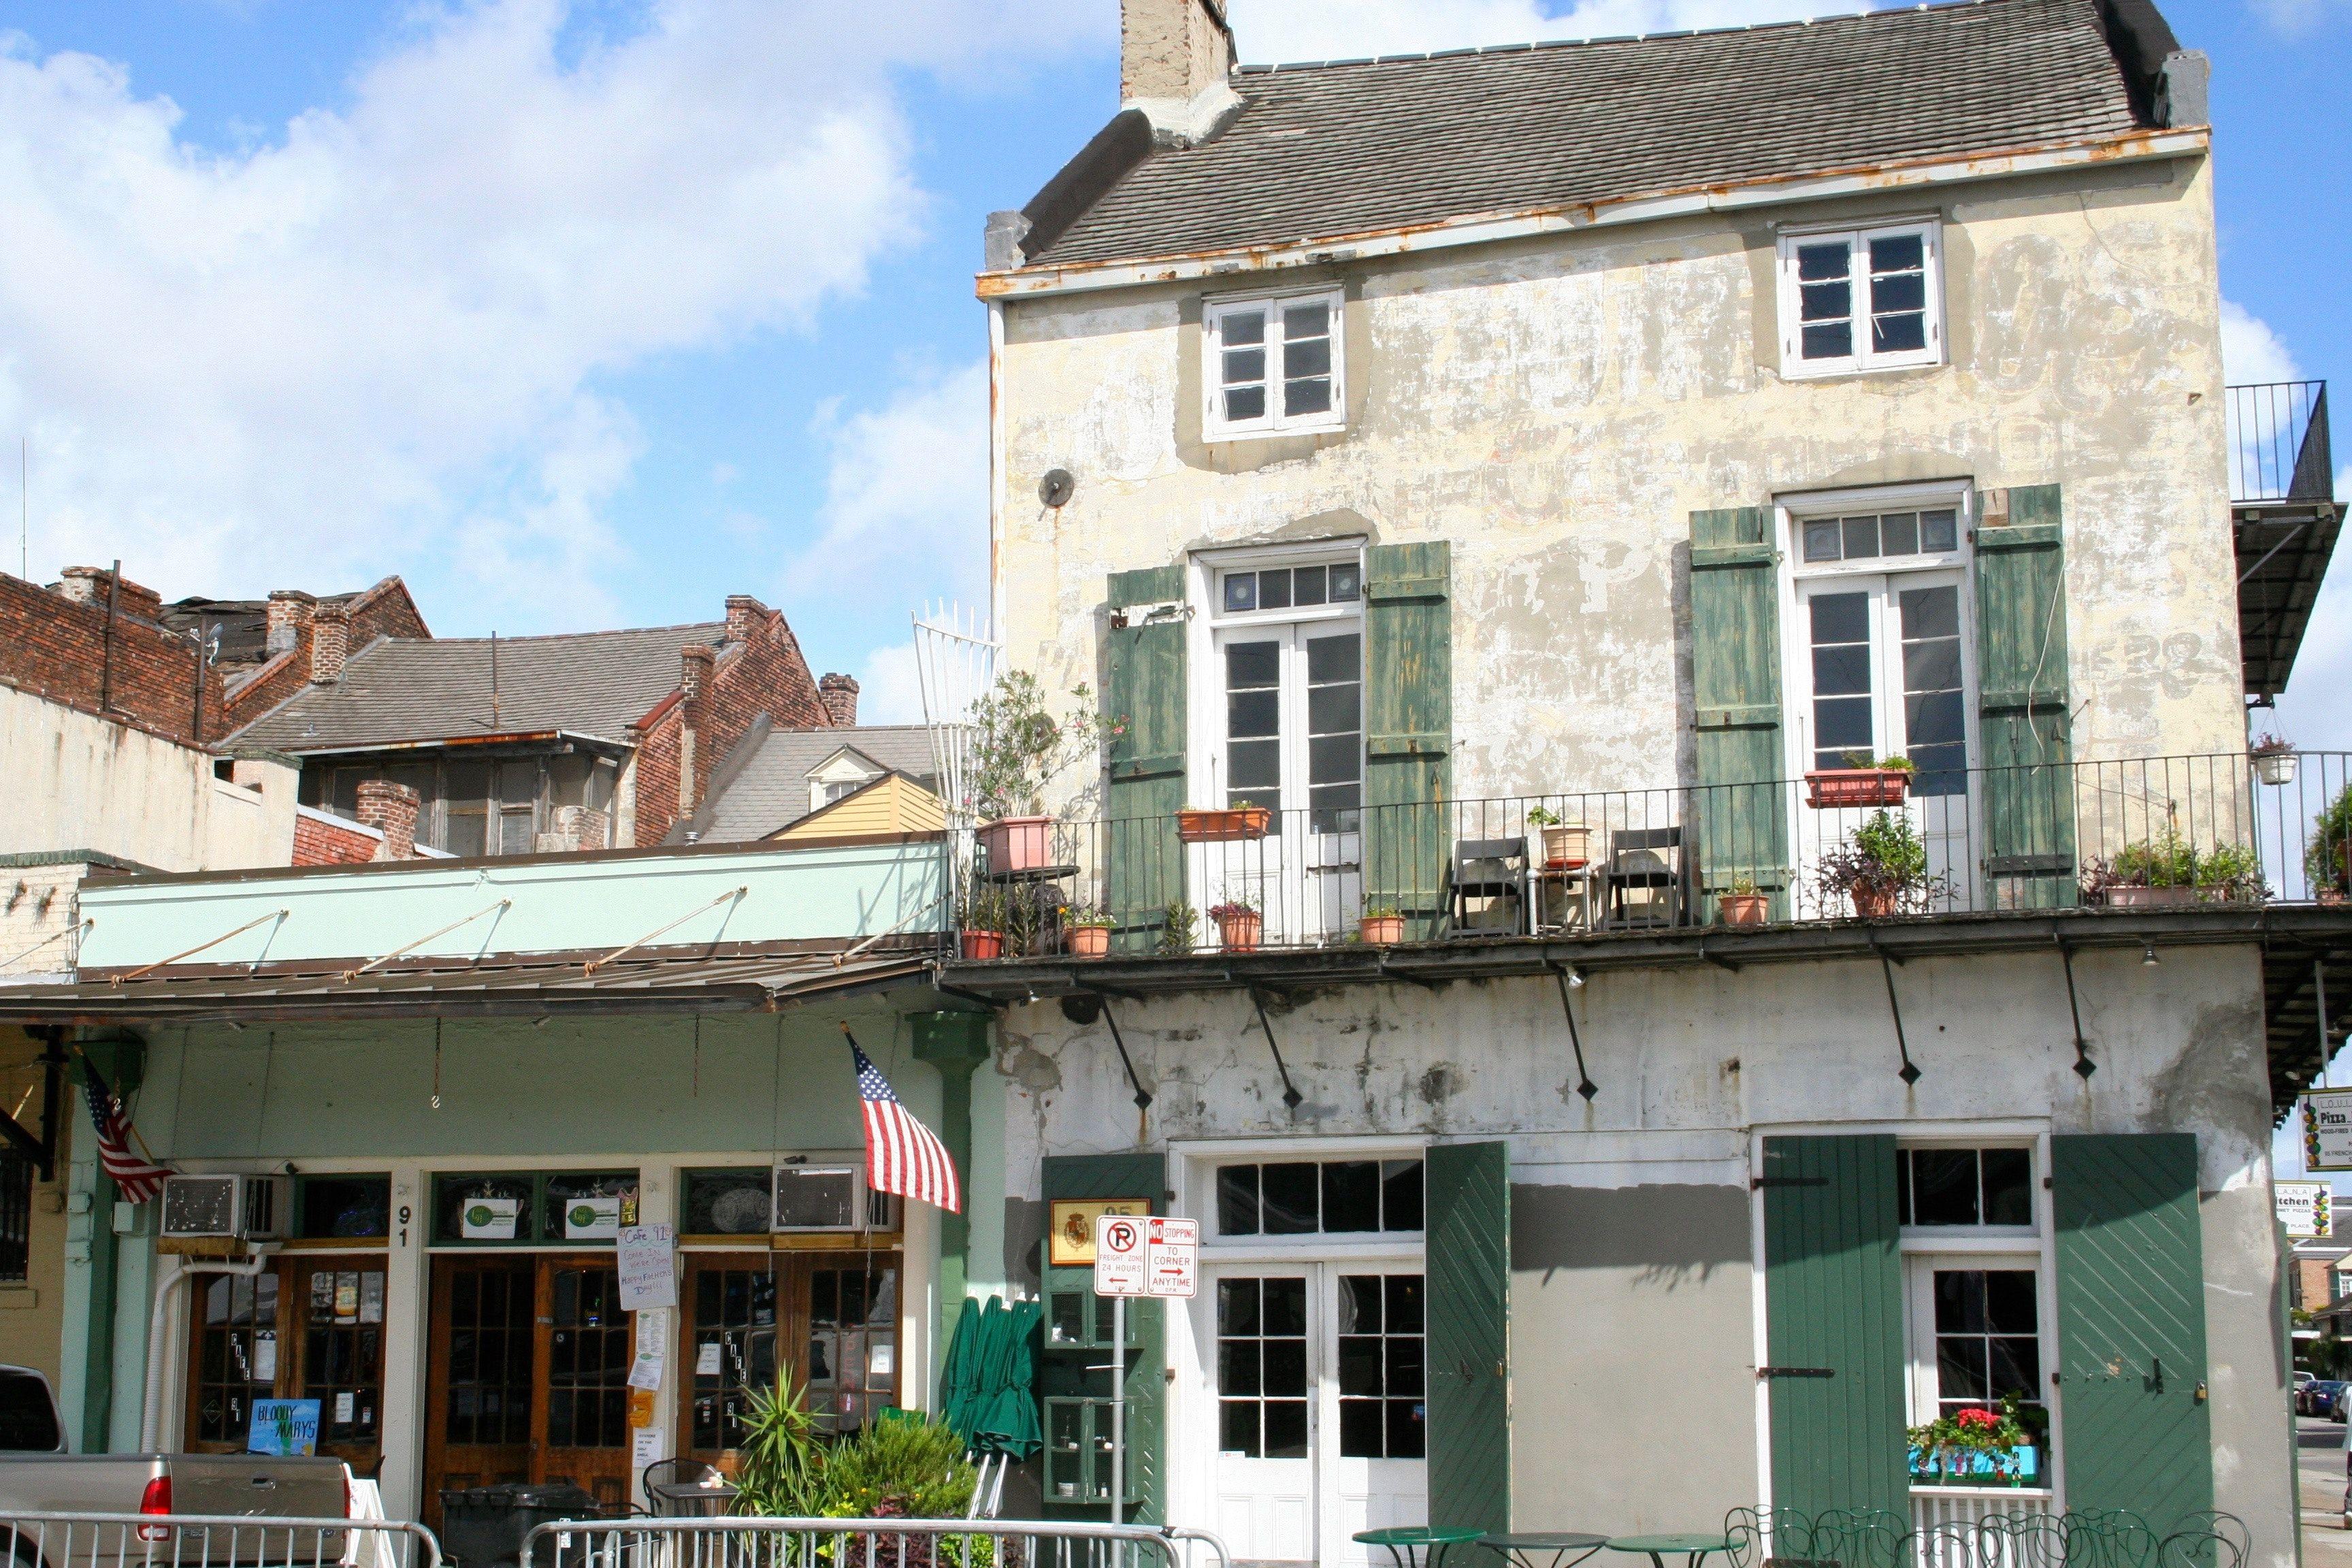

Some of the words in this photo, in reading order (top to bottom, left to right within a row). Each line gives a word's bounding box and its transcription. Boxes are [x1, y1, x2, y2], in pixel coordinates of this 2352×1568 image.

[2320, 1111, 2347, 1124] Pizza
[399, 1205, 412, 1247] 91
[1149, 1224, 1163, 1239] NO
[1164, 1228, 1194, 1239] STOPPING
[1099, 1254, 1124, 1262] FREIGHT
[1166, 1247, 1179, 1256] TO
[1115, 1264, 1142, 1273] HOURS
[1154, 1256, 1190, 1267] CORNER
[1152, 1277, 1191, 1287] ANYTIME
[231, 1333, 250, 1381] CAFE
[725, 1331, 747, 1382] CAFE
[257, 1404, 297, 1422] BLOODY
[274, 1420, 316, 1440] MARYS
